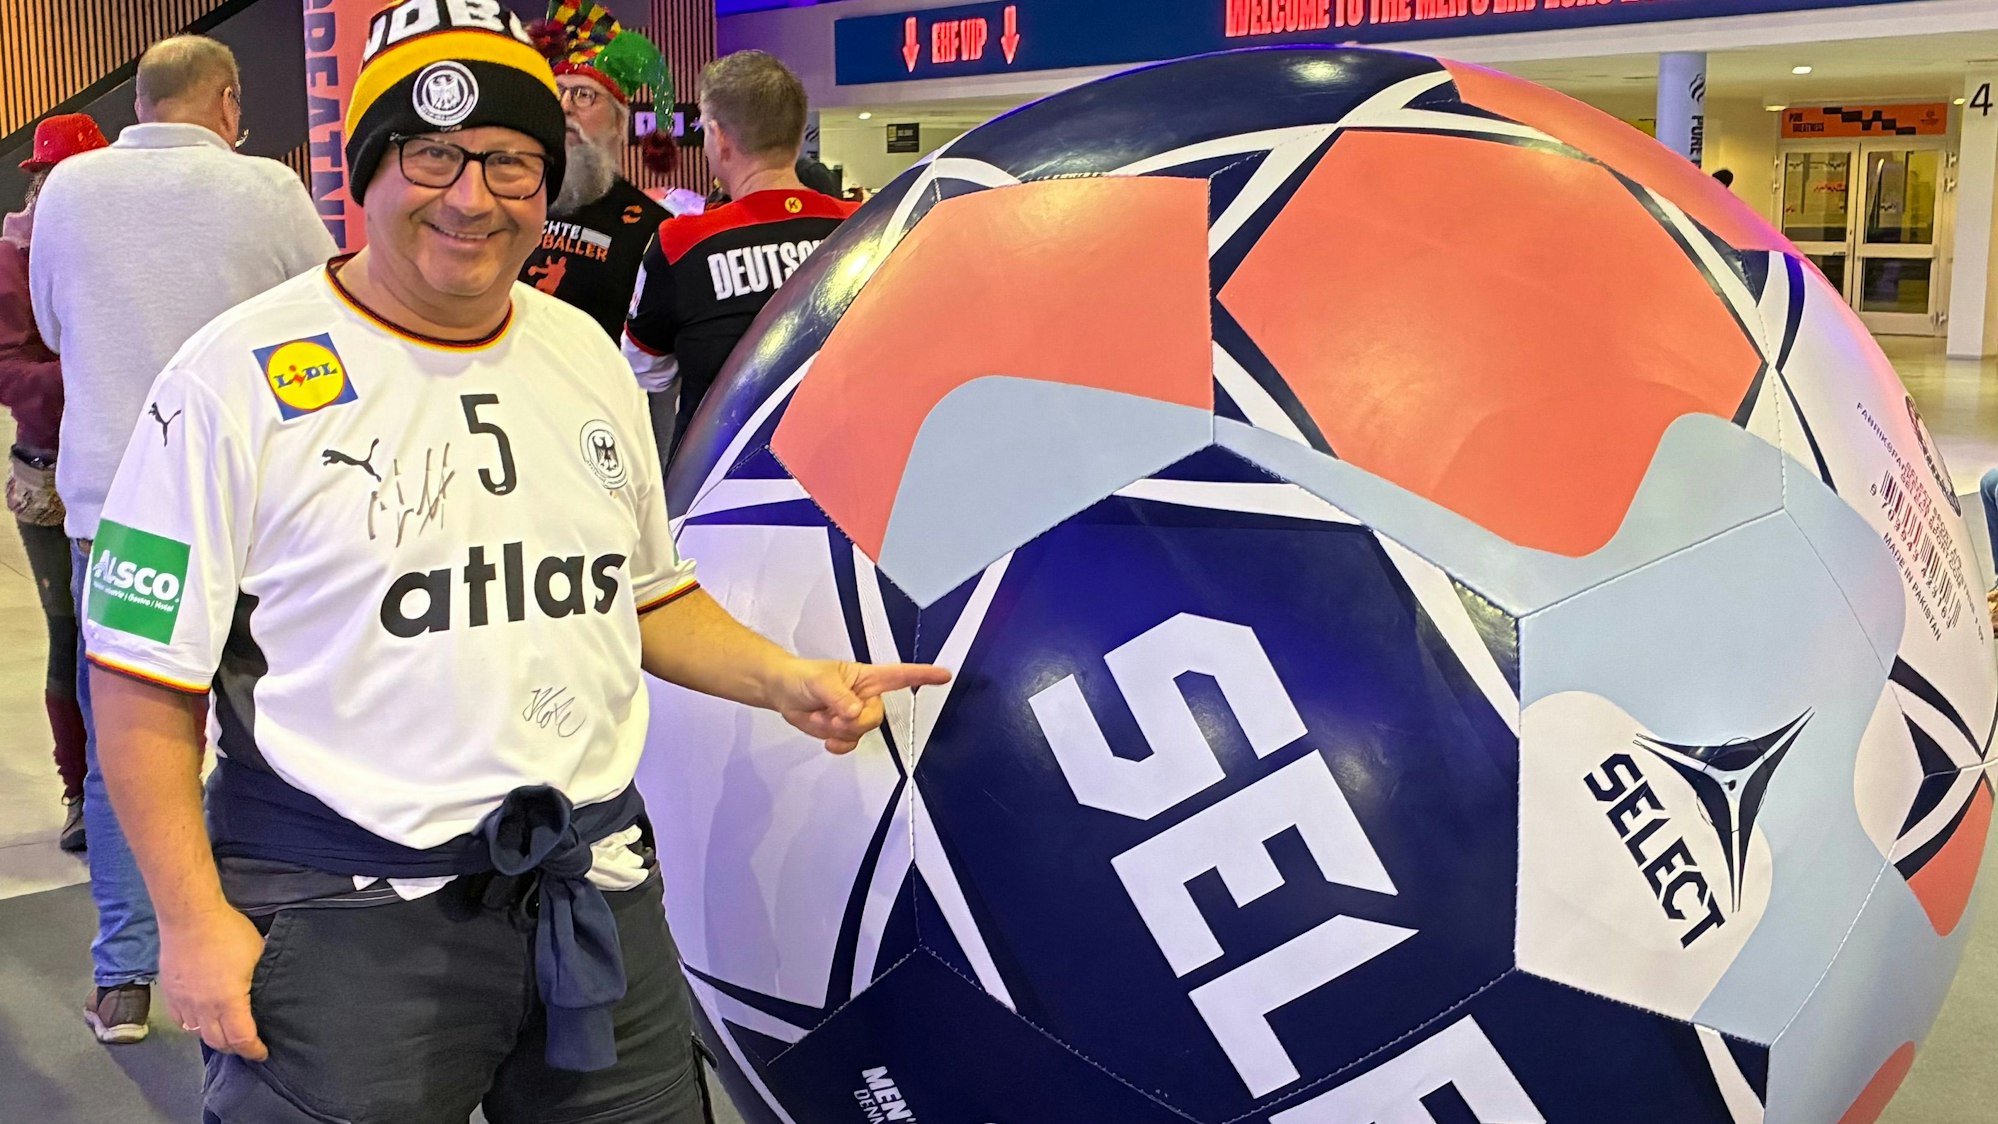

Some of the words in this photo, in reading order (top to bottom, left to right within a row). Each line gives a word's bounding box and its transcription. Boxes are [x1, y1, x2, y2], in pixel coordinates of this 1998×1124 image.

[931, 20, 960, 64] EHF
[960, 17, 988, 61] VIP
[1225, 0, 1330, 37] WELCOME
[1969, 83, 1993, 117] 4
[459, 393, 517, 496] 5
[380, 541, 627, 638] atlas
[1883, 531, 1906, 569] MADE
[1904, 566, 1914, 584] IN
[1911, 581, 1942, 641] PAKISTAN
[1583, 753, 1726, 950] SELECT
